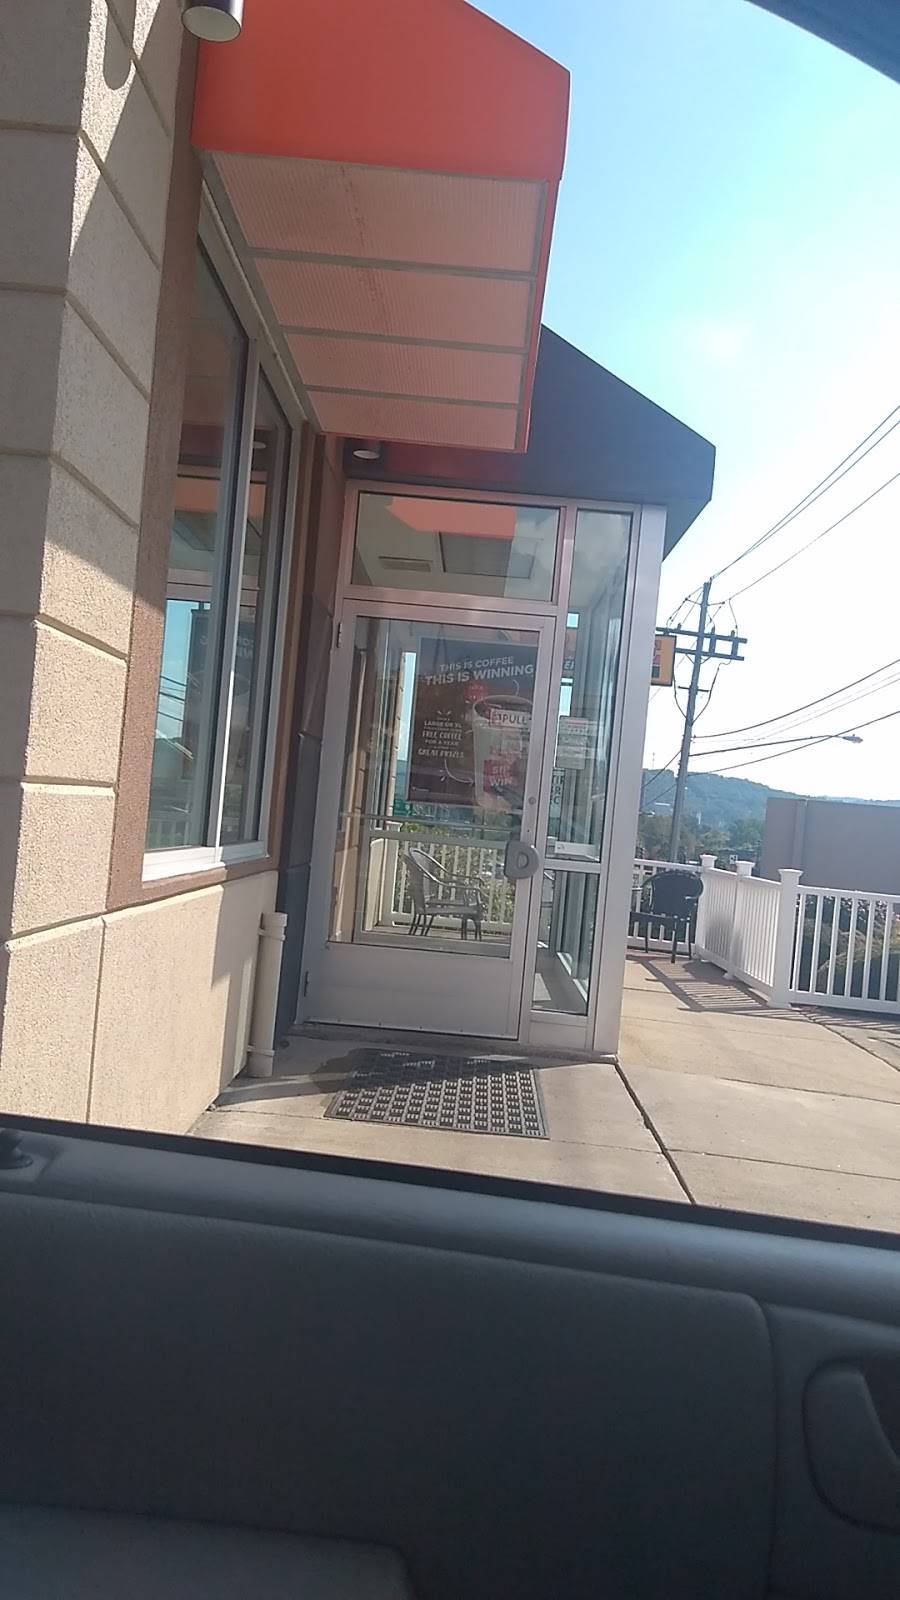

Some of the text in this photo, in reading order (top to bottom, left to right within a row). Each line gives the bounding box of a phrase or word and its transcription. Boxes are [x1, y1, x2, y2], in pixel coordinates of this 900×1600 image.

[439, 656, 514, 672] THIS IS COFFEE
[425, 664, 535, 686] THIS IS WINNING
[502, 714, 528, 726] PULL
